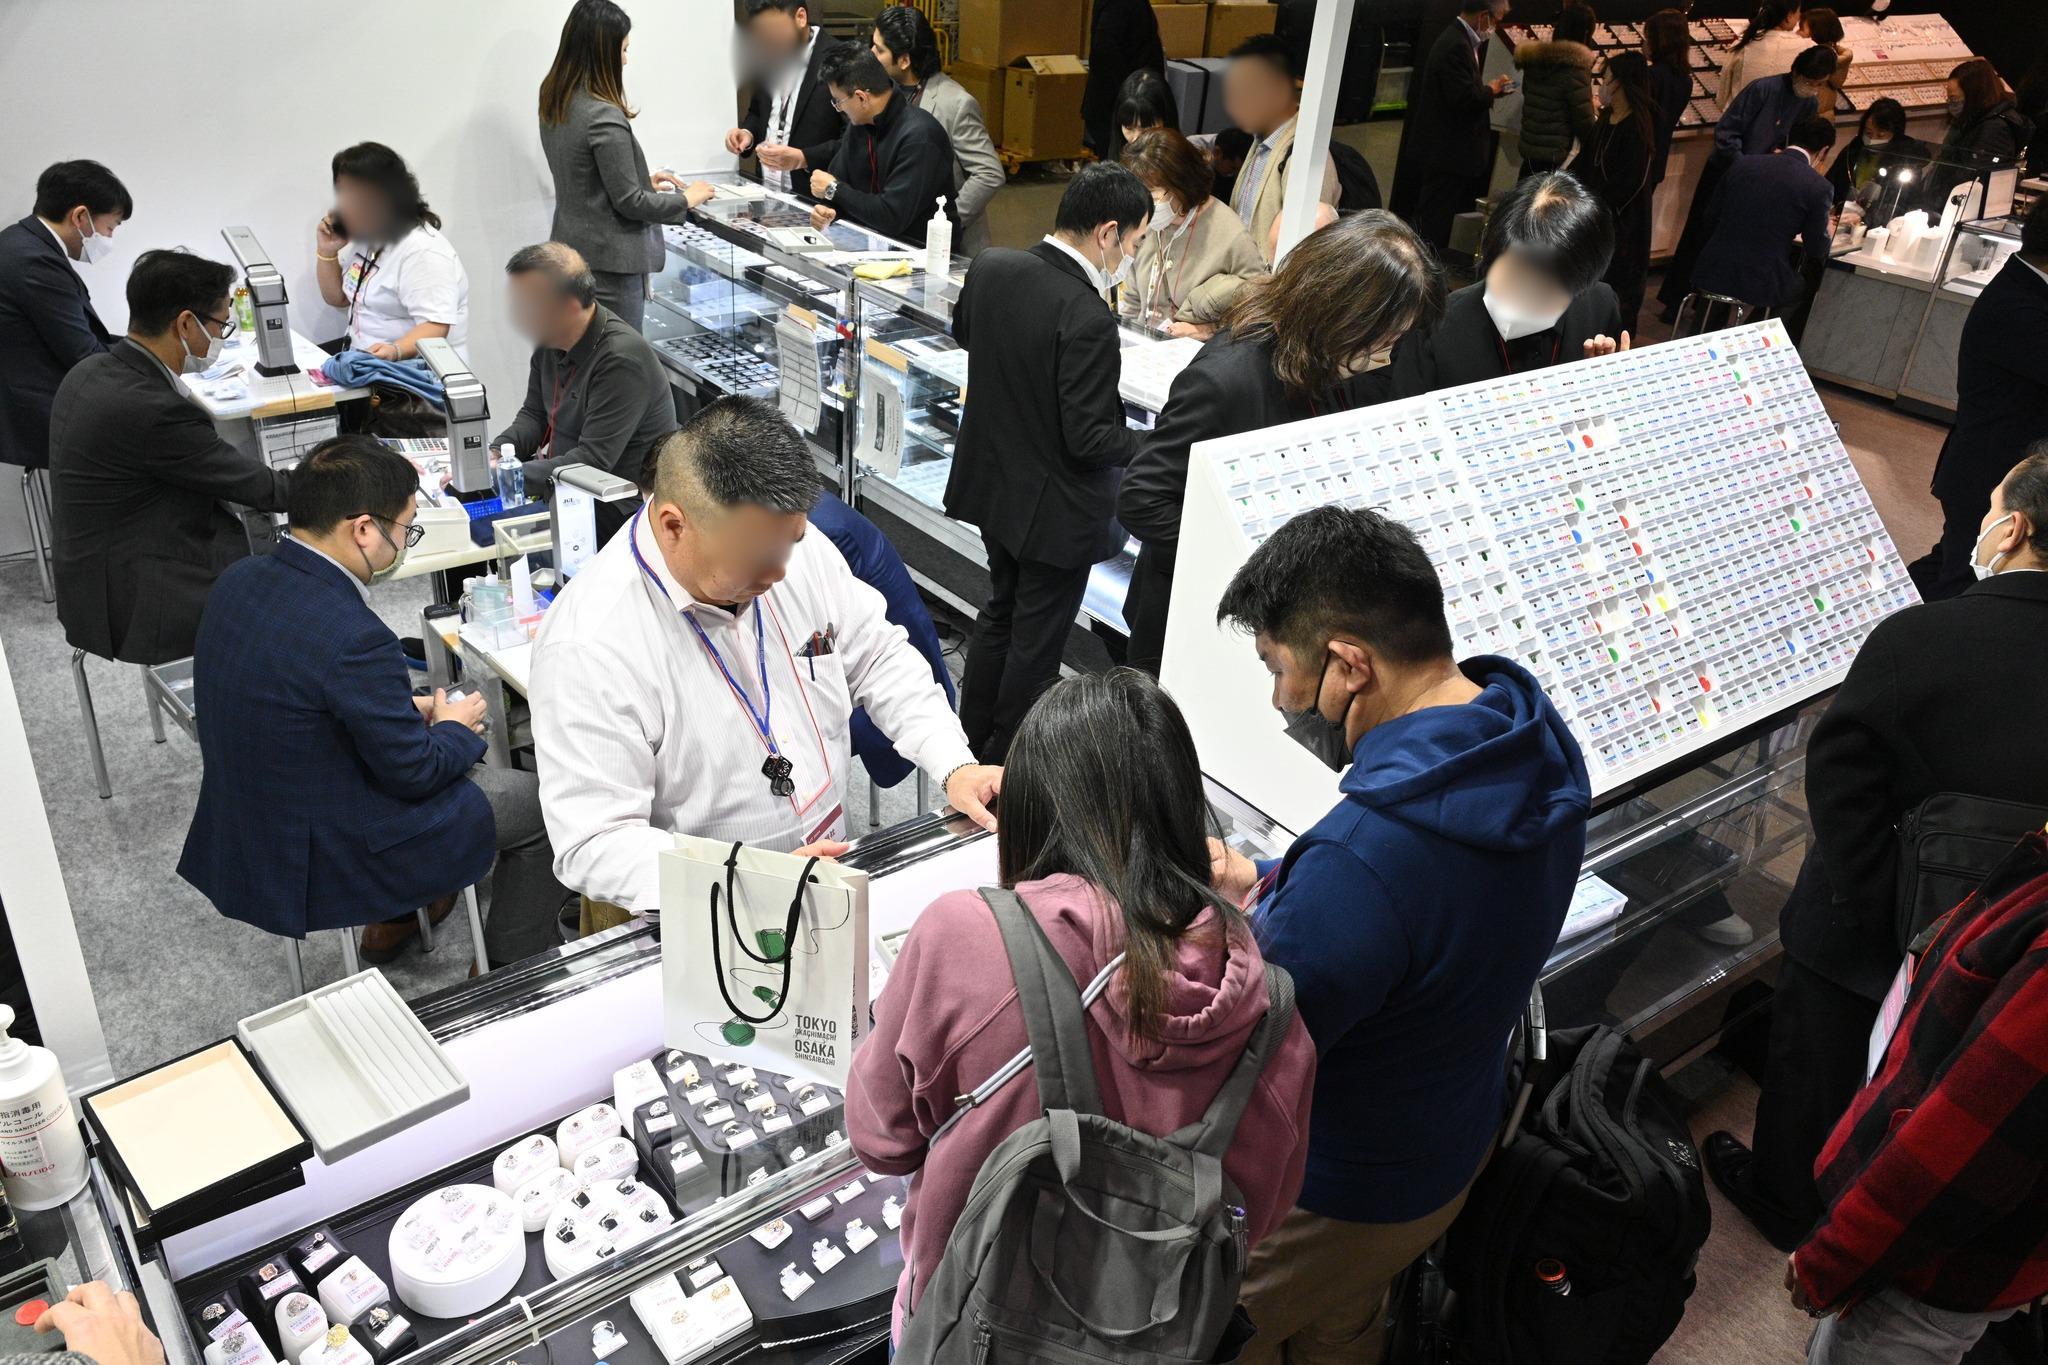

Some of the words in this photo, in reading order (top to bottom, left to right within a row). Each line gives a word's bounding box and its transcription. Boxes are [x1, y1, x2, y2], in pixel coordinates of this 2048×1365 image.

[795, 1014, 836, 1033] TOKYO
[795, 1028, 837, 1041] OKACHIMACHI
[795, 1039, 836, 1058] OSAKA
[795, 1052, 836, 1066] SHINSAIBASHI
[0, 1112, 43, 1127] ルコール
[14, 1119, 46, 1133] SANITIZER
